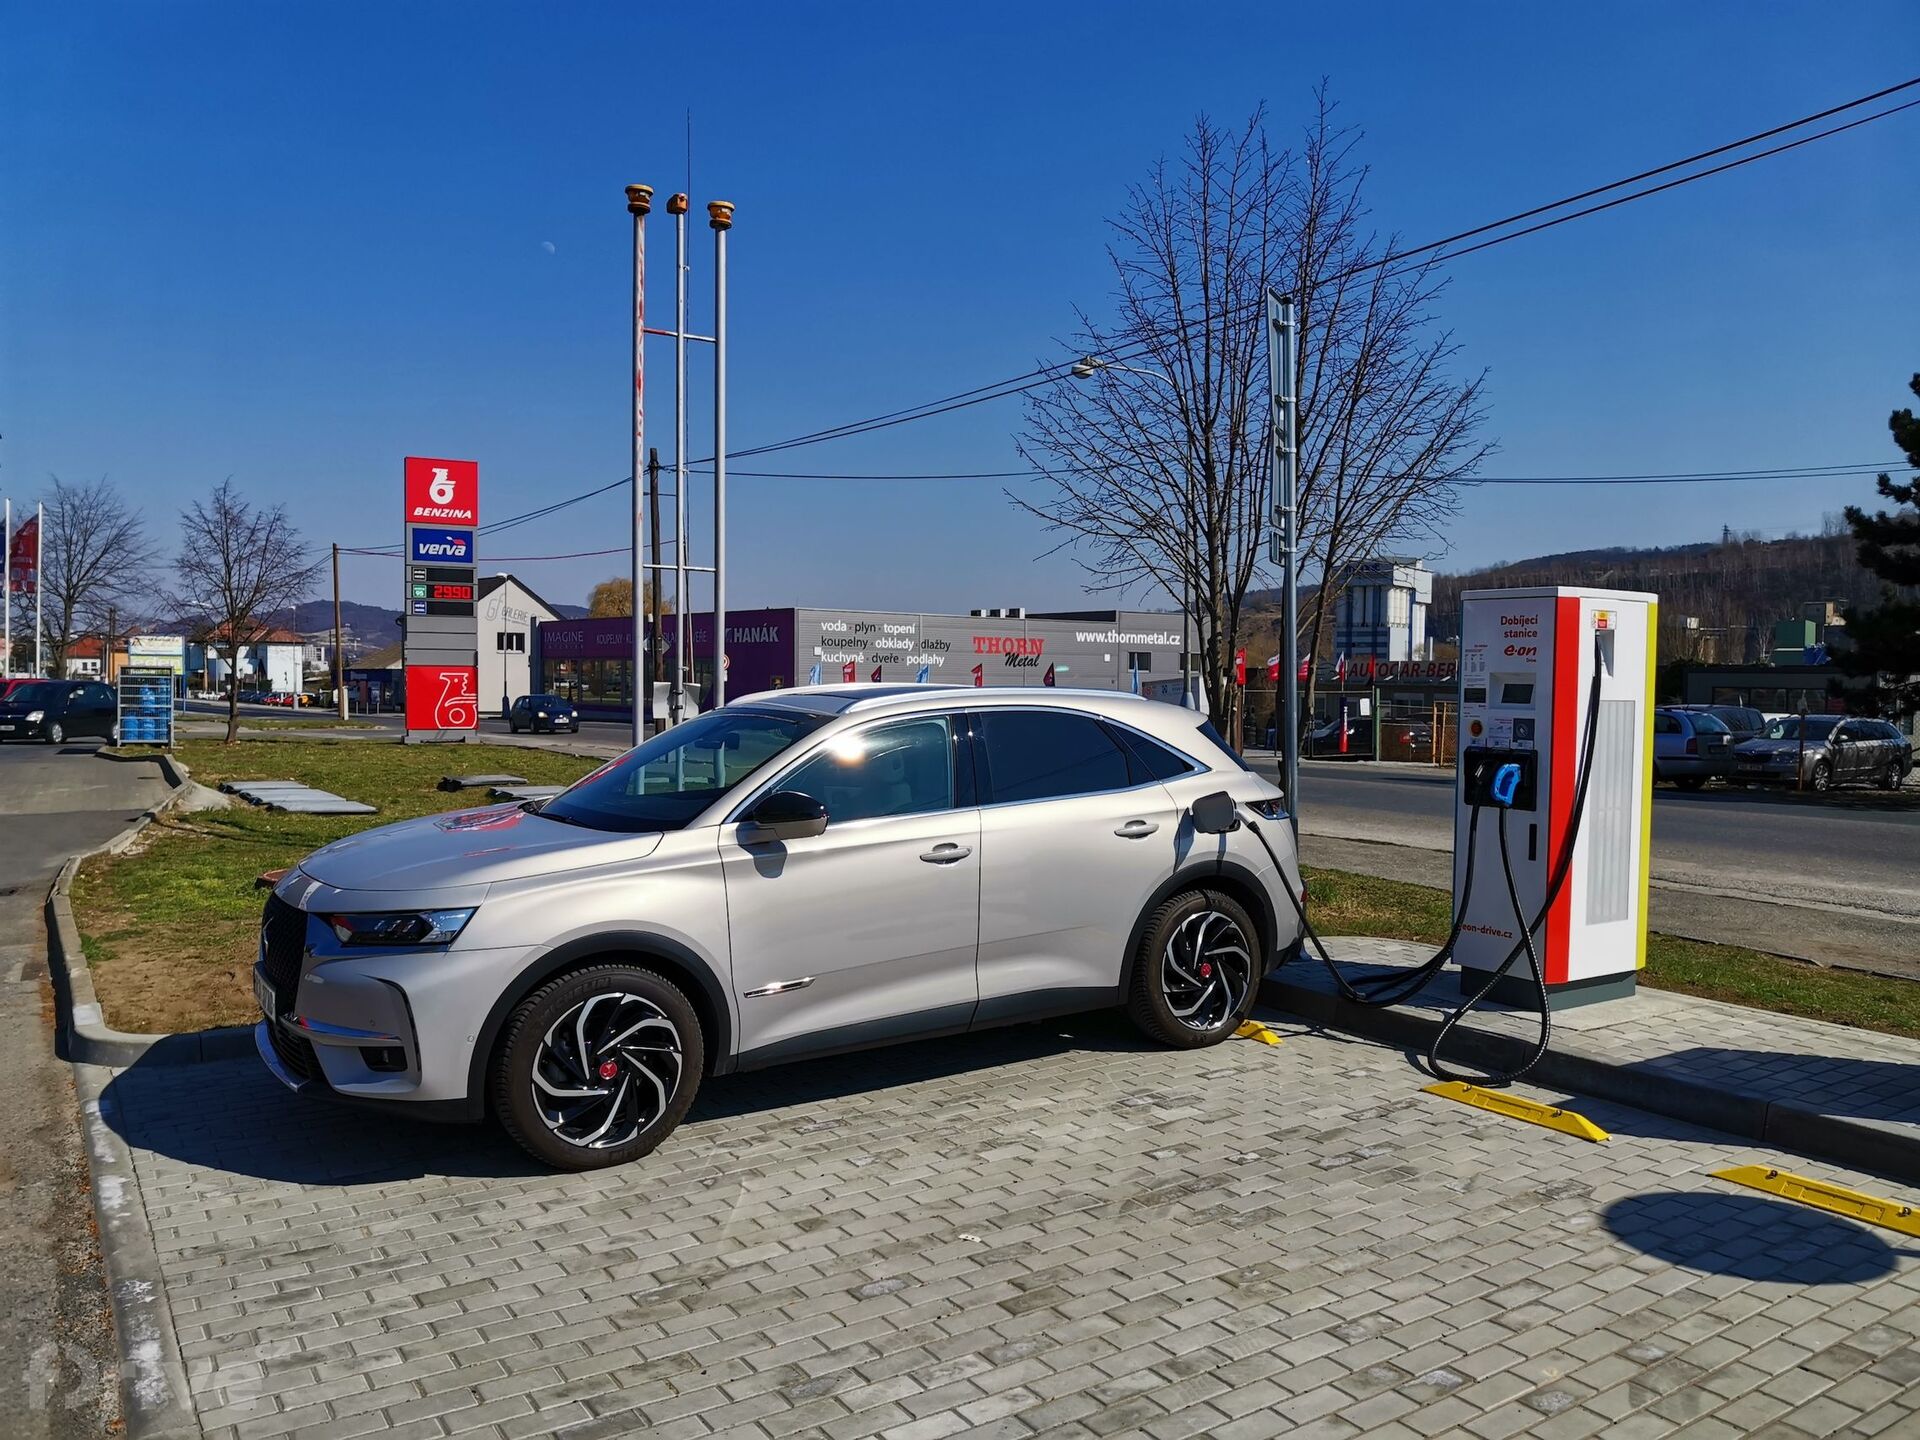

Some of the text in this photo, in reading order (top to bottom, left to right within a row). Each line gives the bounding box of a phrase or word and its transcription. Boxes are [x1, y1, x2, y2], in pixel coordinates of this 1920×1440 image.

[413, 507, 472, 519] BENZINA
[418, 543, 467, 556] verva
[821, 620, 916, 636] voda plyn topení
[1500, 614, 1538, 627] Dobíjecí
[544, 630, 584, 643] IMAGINE
[1076, 629, 1181, 646] www.thornmetal.cz
[1503, 628, 1538, 638] stanice
[820, 636, 951, 652] koupelny obklady dlažby
[973, 637, 1044, 655] THORN
[820, 650, 945, 666] kuchyně dveře podlahy
[1004, 652, 1040, 667] Metal
